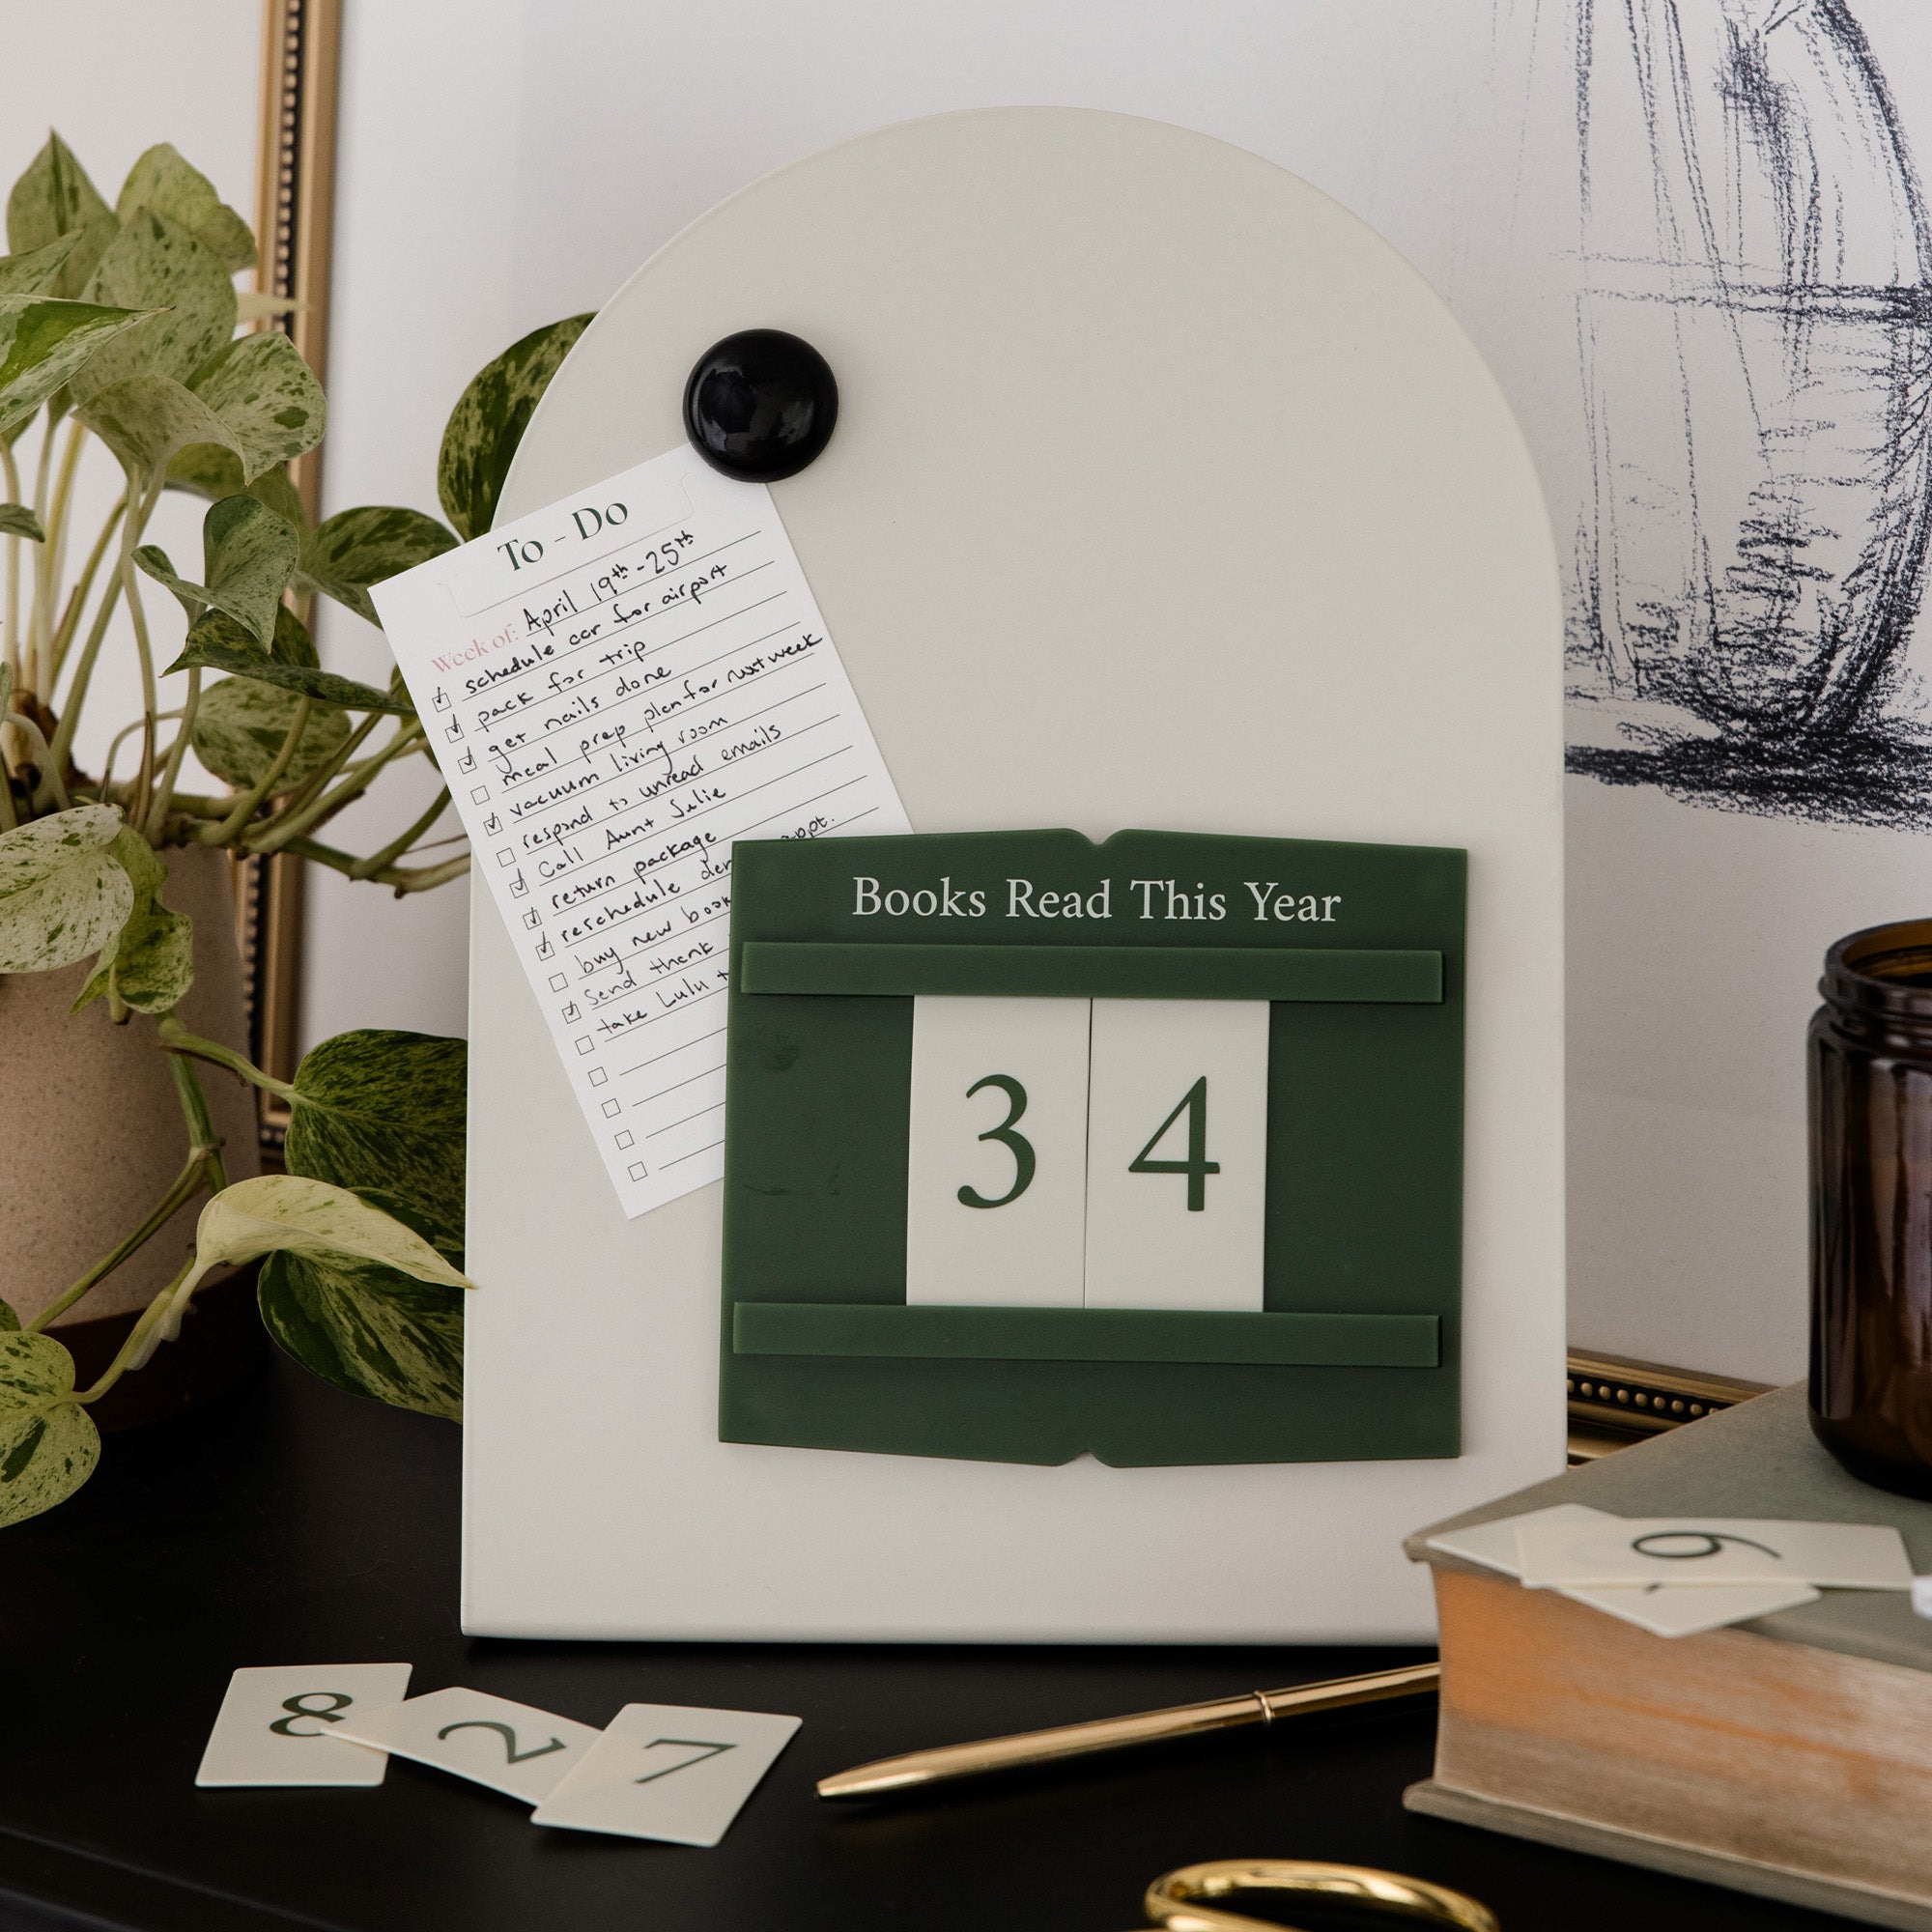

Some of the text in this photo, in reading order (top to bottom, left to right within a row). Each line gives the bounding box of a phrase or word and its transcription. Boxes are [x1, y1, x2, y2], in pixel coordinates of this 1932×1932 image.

[497, 537, 545, 572] To
[571, 501, 629, 541] Do
[431, 636, 488, 673] Week
[490, 624, 519, 650] of:
[523, 589, 578, 637] April
[466, 564, 727, 695] schedule car for airport
[478, 640, 646, 732] pack for trip
[488, 667, 671, 775] get nails done
[499, 747, 557, 786] meal
[580, 724, 627, 764] prep
[683, 679, 718, 699] for
[767, 634, 823, 664] week
[509, 717, 728, 816] vacuum living room
[523, 724, 781, 849] respond to unread emails
[539, 788, 726, 878] Call Aunt Julie
[552, 833, 717, 909] return package
[561, 879, 681, 942] reschedule
[851, 876, 1342, 922] Books Read This Year
[574, 947, 630, 975] buy
[632, 920, 672, 948] new
[597, 1010, 647, 1034] take
[269, 1691, 354, 1738] 8
[438, 1719, 568, 1765] 2
[635, 1738, 737, 1784] 7
